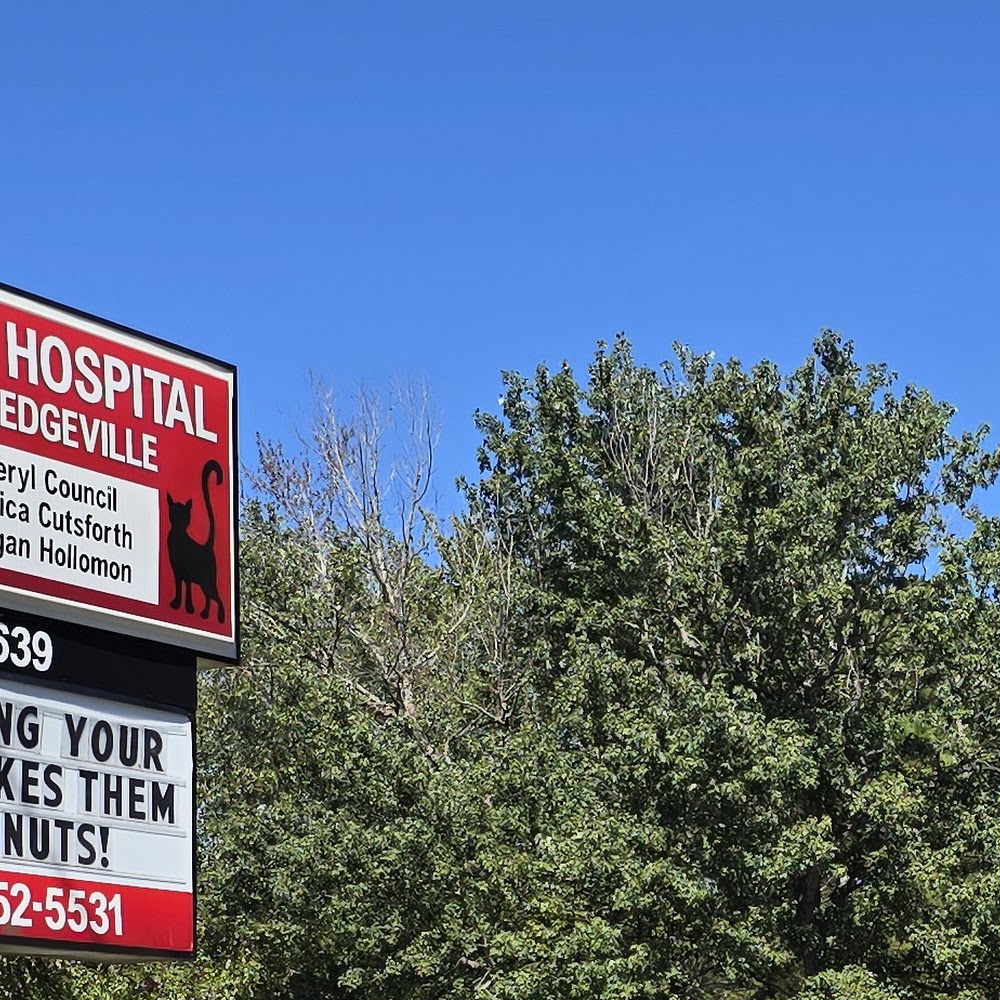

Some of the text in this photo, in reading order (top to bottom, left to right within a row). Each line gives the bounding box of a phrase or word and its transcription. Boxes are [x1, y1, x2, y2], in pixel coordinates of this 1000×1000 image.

[6, 320, 218, 444] HOSPITAL
[0, 388, 159, 473] EDGEVILLE
[45, 469, 117, 513] Council
[0, 490, 133, 551] ica Cutsforth
[40, 536, 132, 584] Hollomon
[0, 701, 165, 772] NG YOUR
[79, 769, 175, 824] THEM
[4, 812, 110, 868] NUTS!
